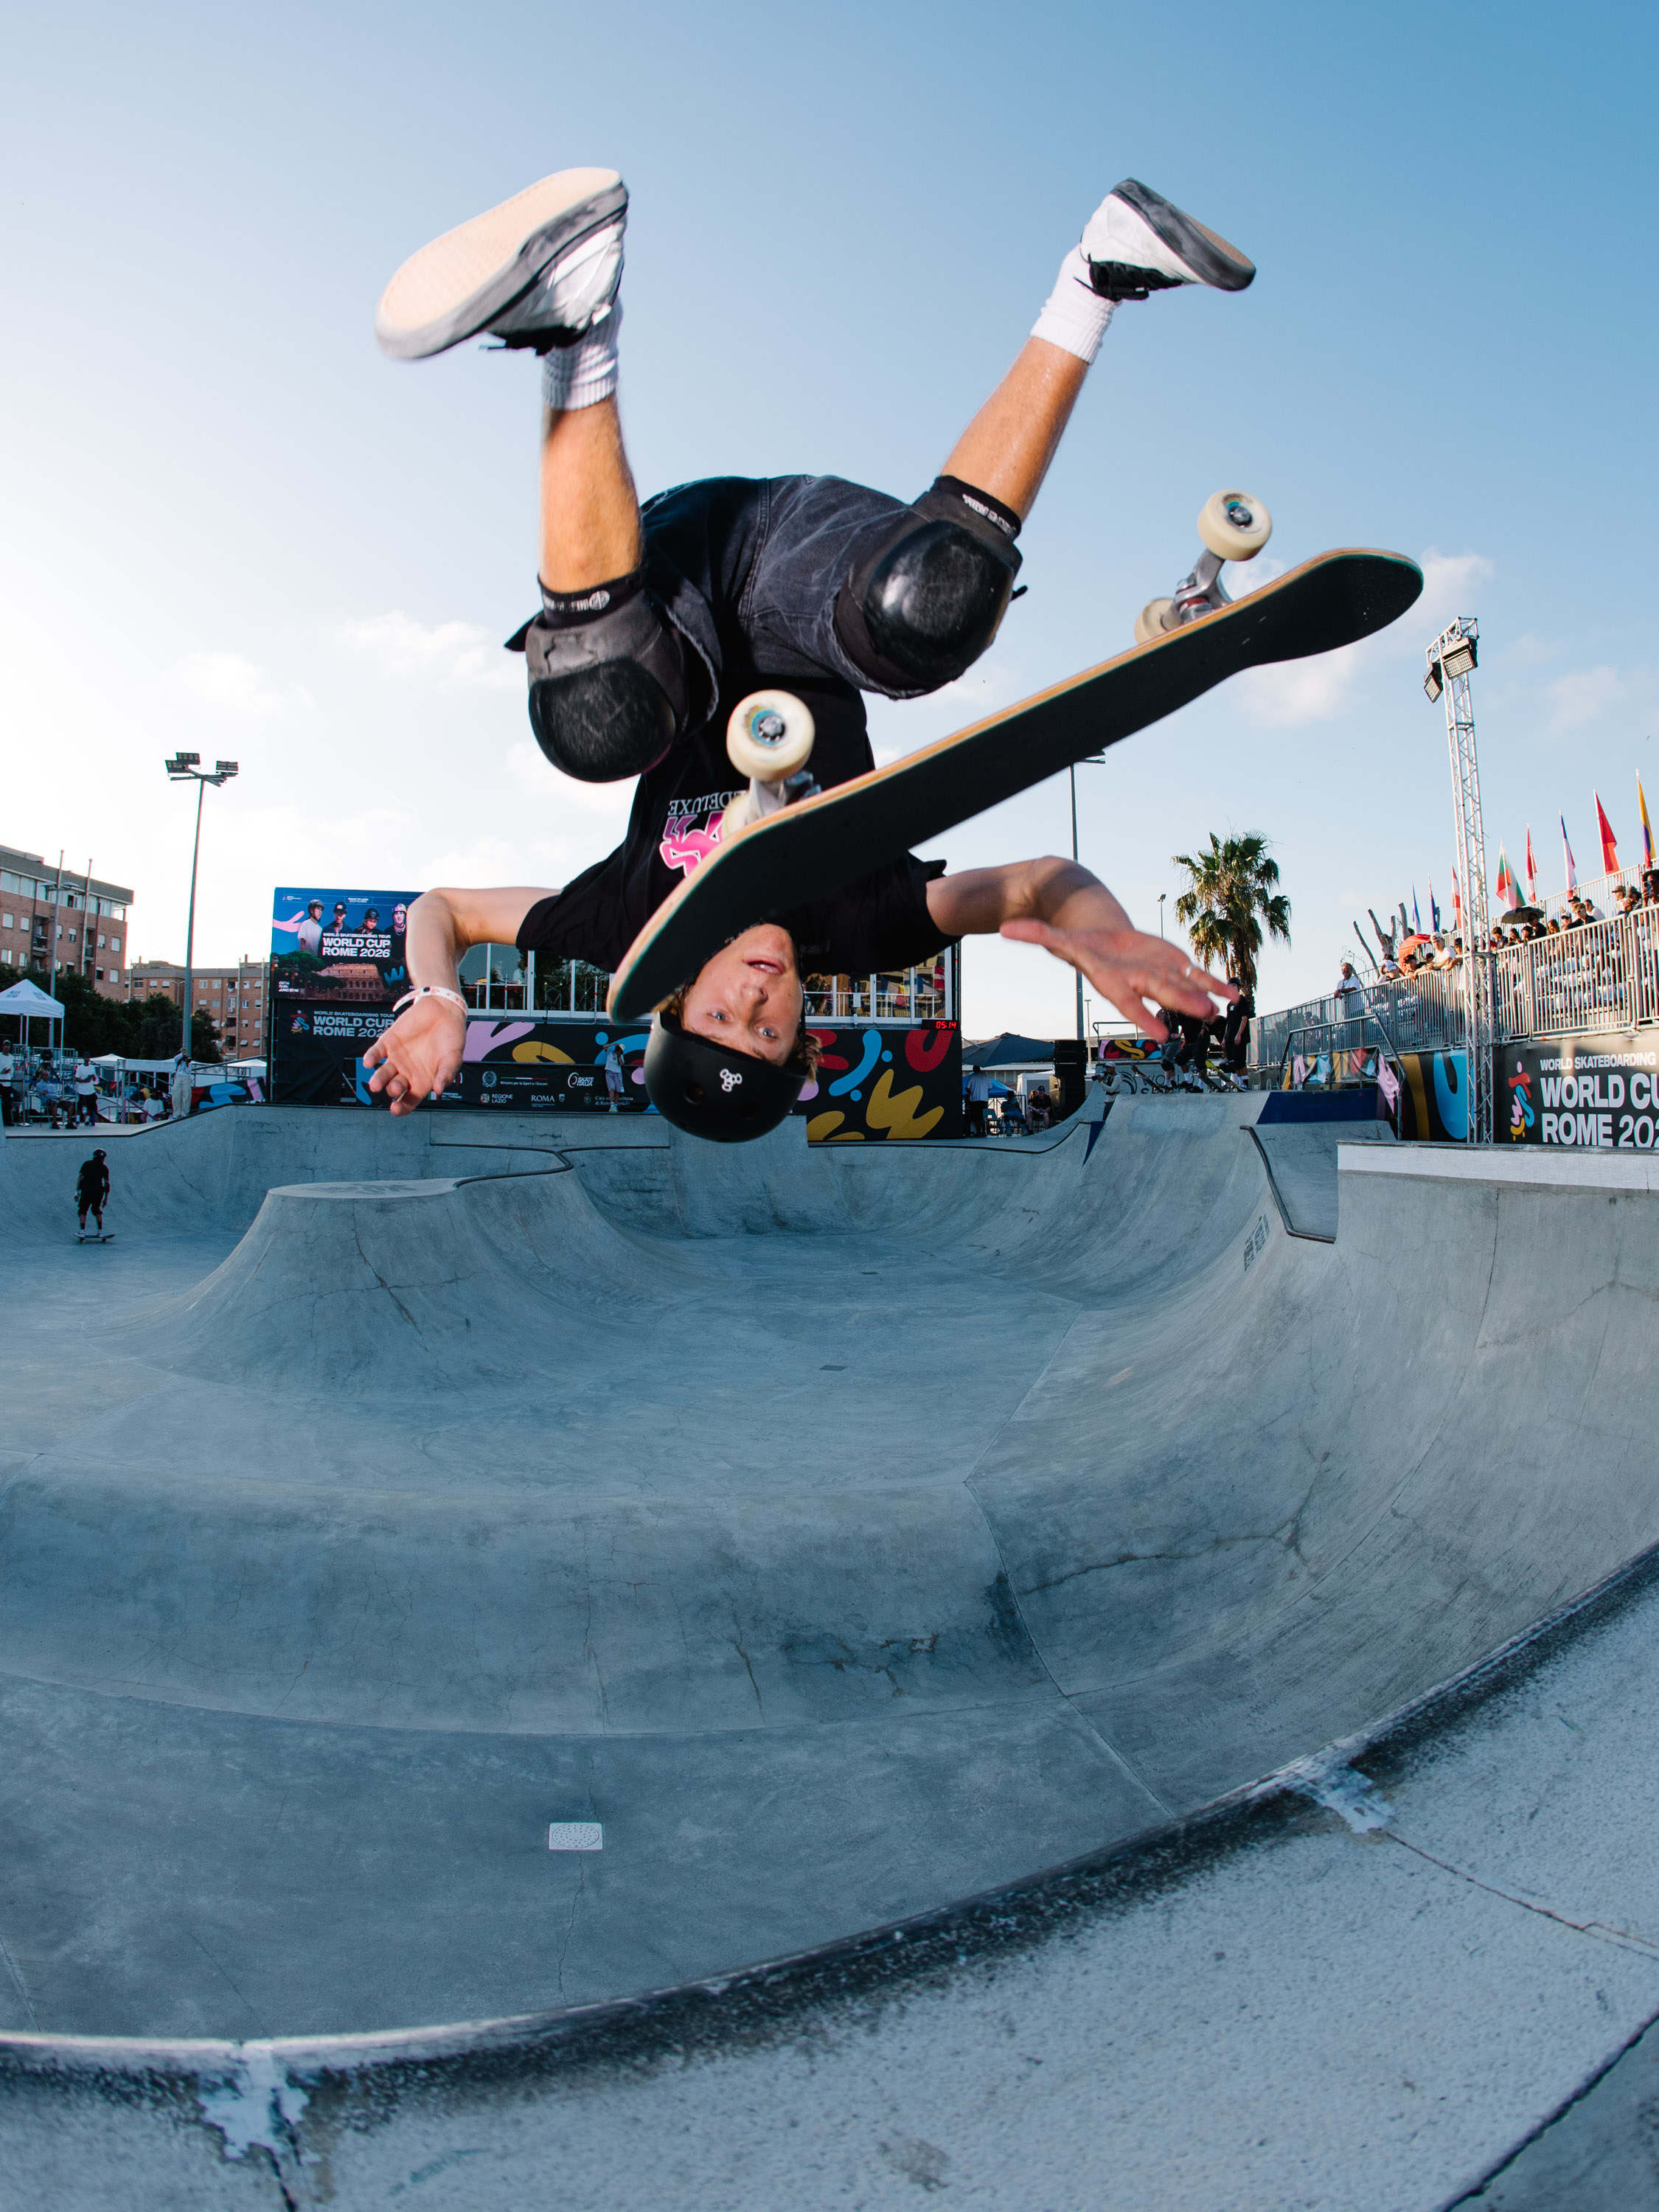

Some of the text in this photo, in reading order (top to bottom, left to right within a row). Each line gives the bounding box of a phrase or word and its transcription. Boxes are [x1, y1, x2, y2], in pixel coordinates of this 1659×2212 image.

[322, 937, 391, 948] WORLD CUP
[322, 947, 391, 958] ROME 2026
[313, 1015, 394, 1028] WORLD CUP
[313, 1026, 355, 1037] ROME
[1540, 1051, 1657, 1071] WORLD SKATEBOARDING
[1540, 1074, 1625, 1108] WORLD
[1541, 1113, 1659, 1147] ROME 20
